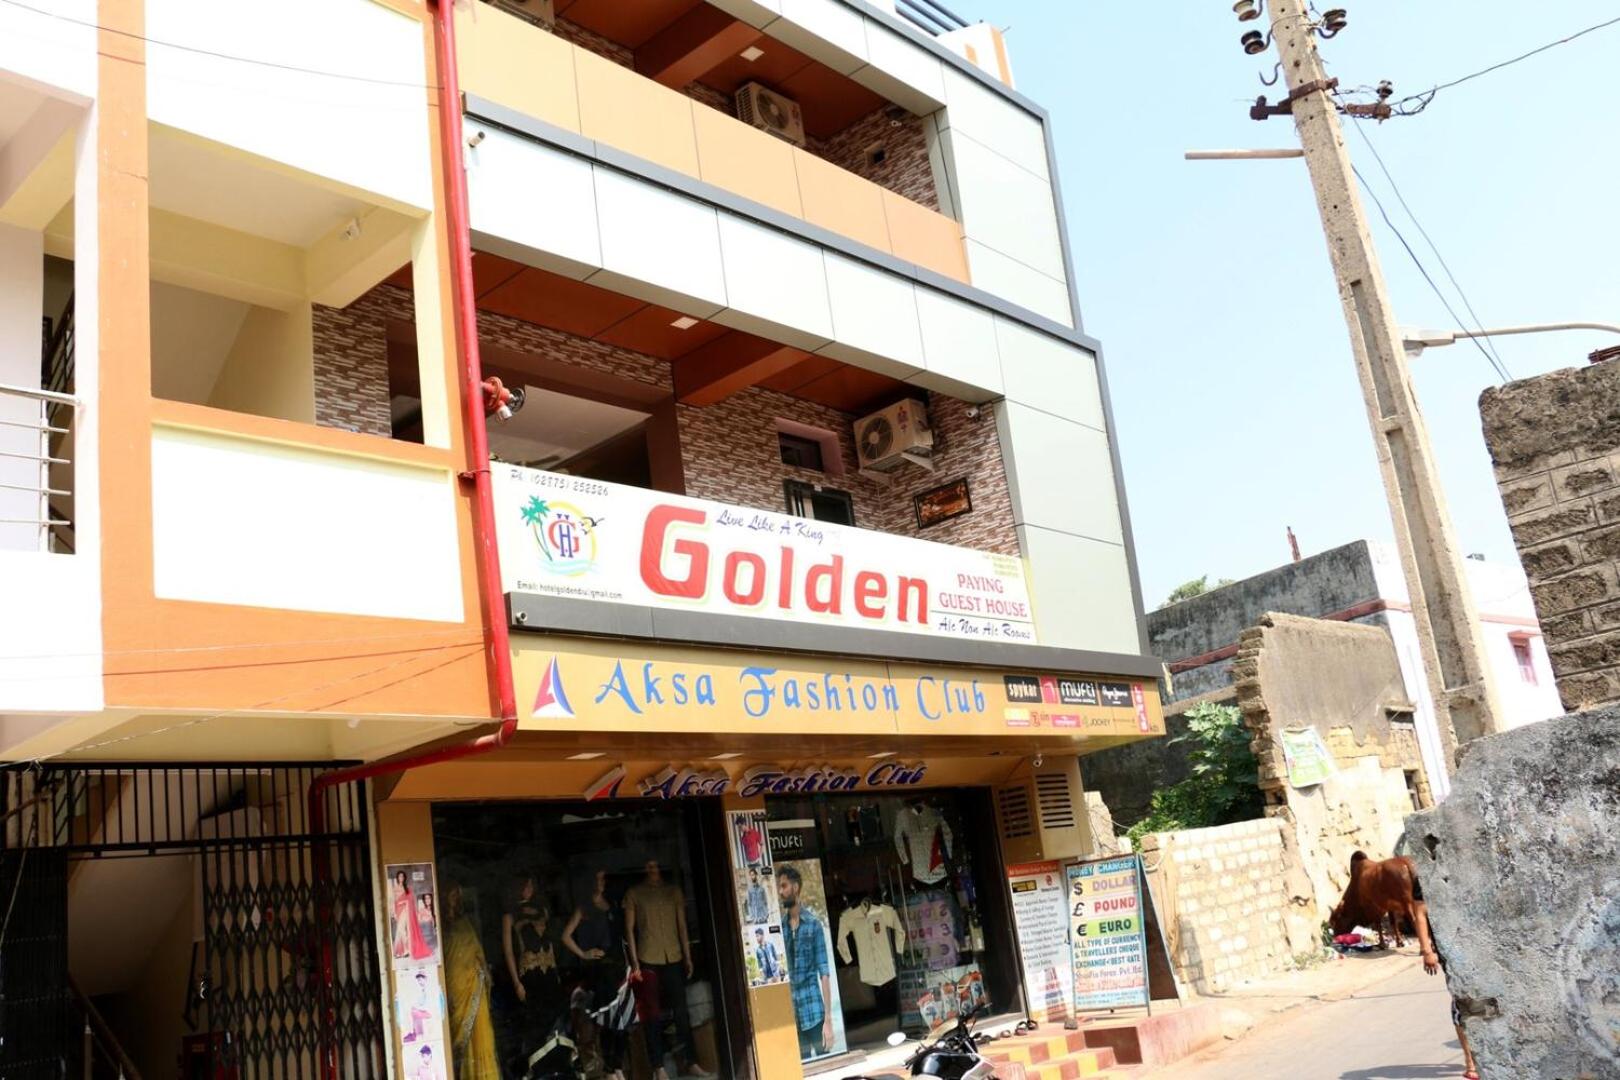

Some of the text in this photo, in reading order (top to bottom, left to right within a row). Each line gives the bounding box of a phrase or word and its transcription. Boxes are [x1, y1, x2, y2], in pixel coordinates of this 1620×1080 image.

[716, 509, 824, 544] Live Like A King
[639, 503, 930, 625] Golden
[957, 573, 1004, 594] PAYING
[938, 592, 1028, 618] GUEST HOUSE
[595, 657, 986, 720] Aksa Fashion Club
[1008, 680, 1038, 698] spykar
[1060, 681, 1096, 698] mufti
[640, 760, 928, 799] Aksa Fashion Club
[769, 834, 804, 849] mufti
[1092, 876, 1137, 891] DOLLAR
[1094, 897, 1136, 913] POUND
[1099, 919, 1132, 933] EURO
[1074, 940, 1086, 949] ALL
[1088, 938, 1102, 947] TYPE
